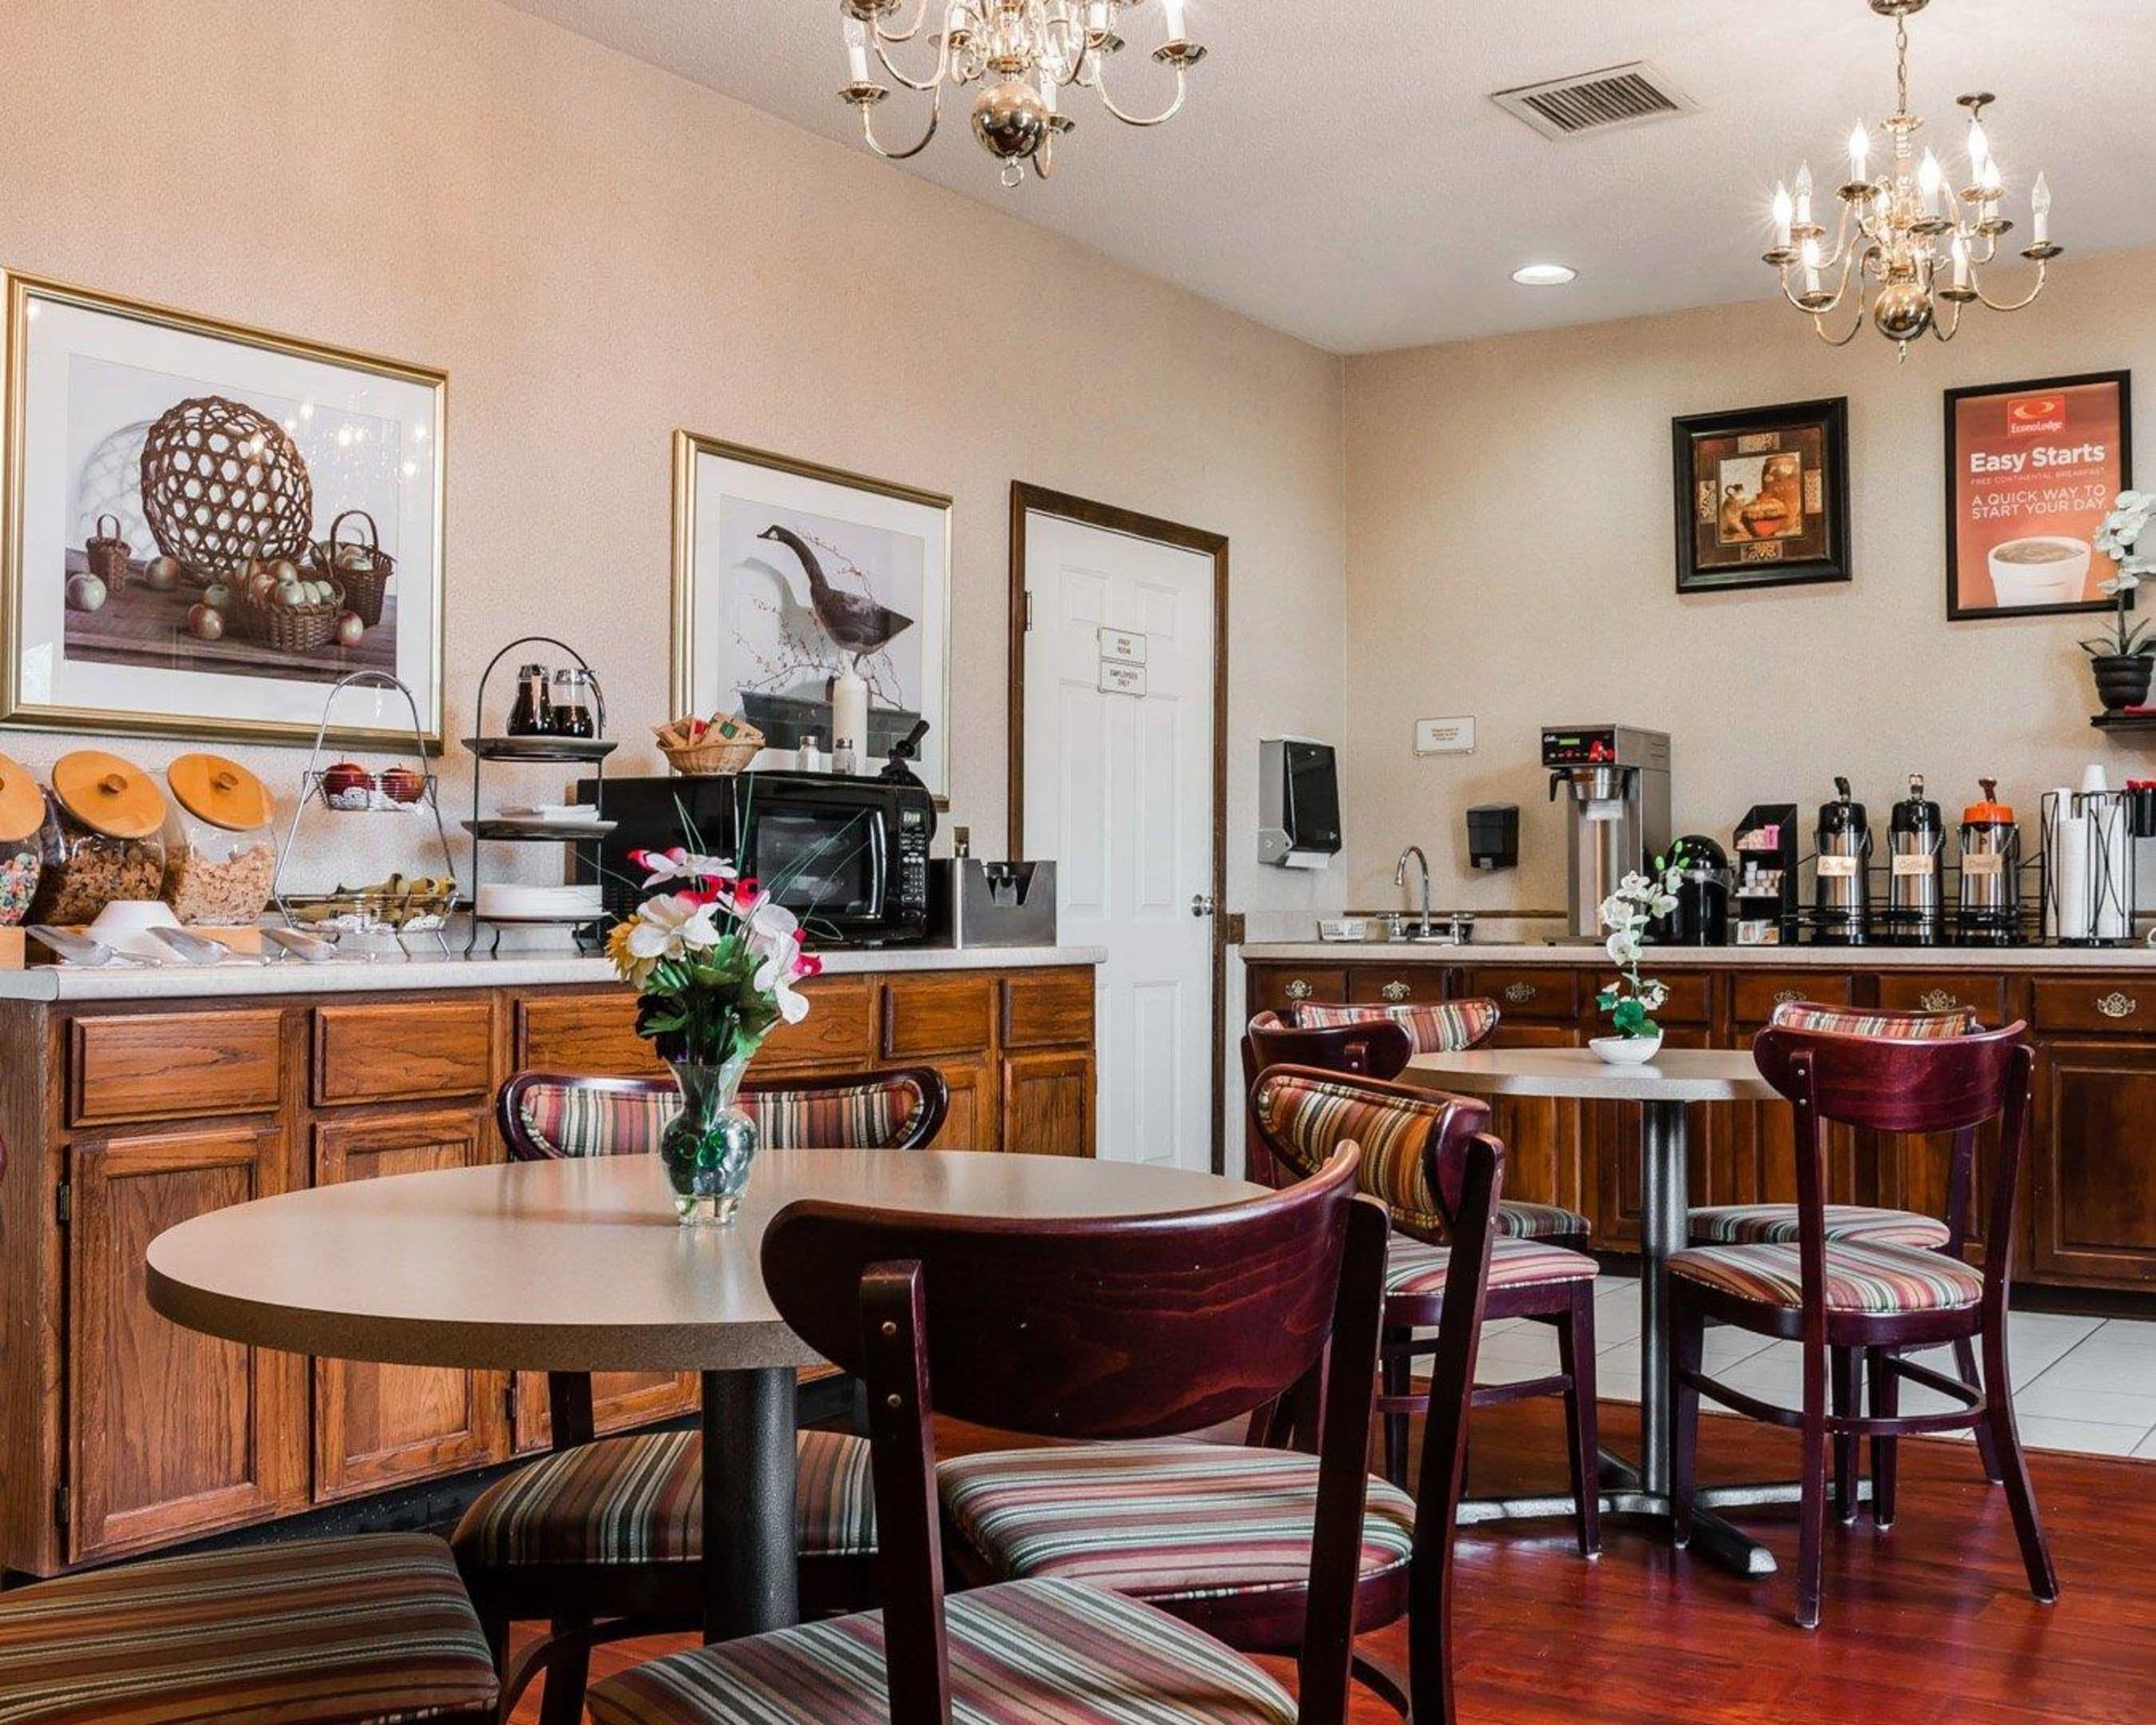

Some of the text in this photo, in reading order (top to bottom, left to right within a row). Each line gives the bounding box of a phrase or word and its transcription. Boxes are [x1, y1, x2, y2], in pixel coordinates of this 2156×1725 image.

[1970, 442, 2105, 473] Easy Starts
[1972, 484, 2106, 506] A QUICK WAY TO
[1972, 504, 2020, 520] START
[2026, 501, 2068, 514] YOUR
